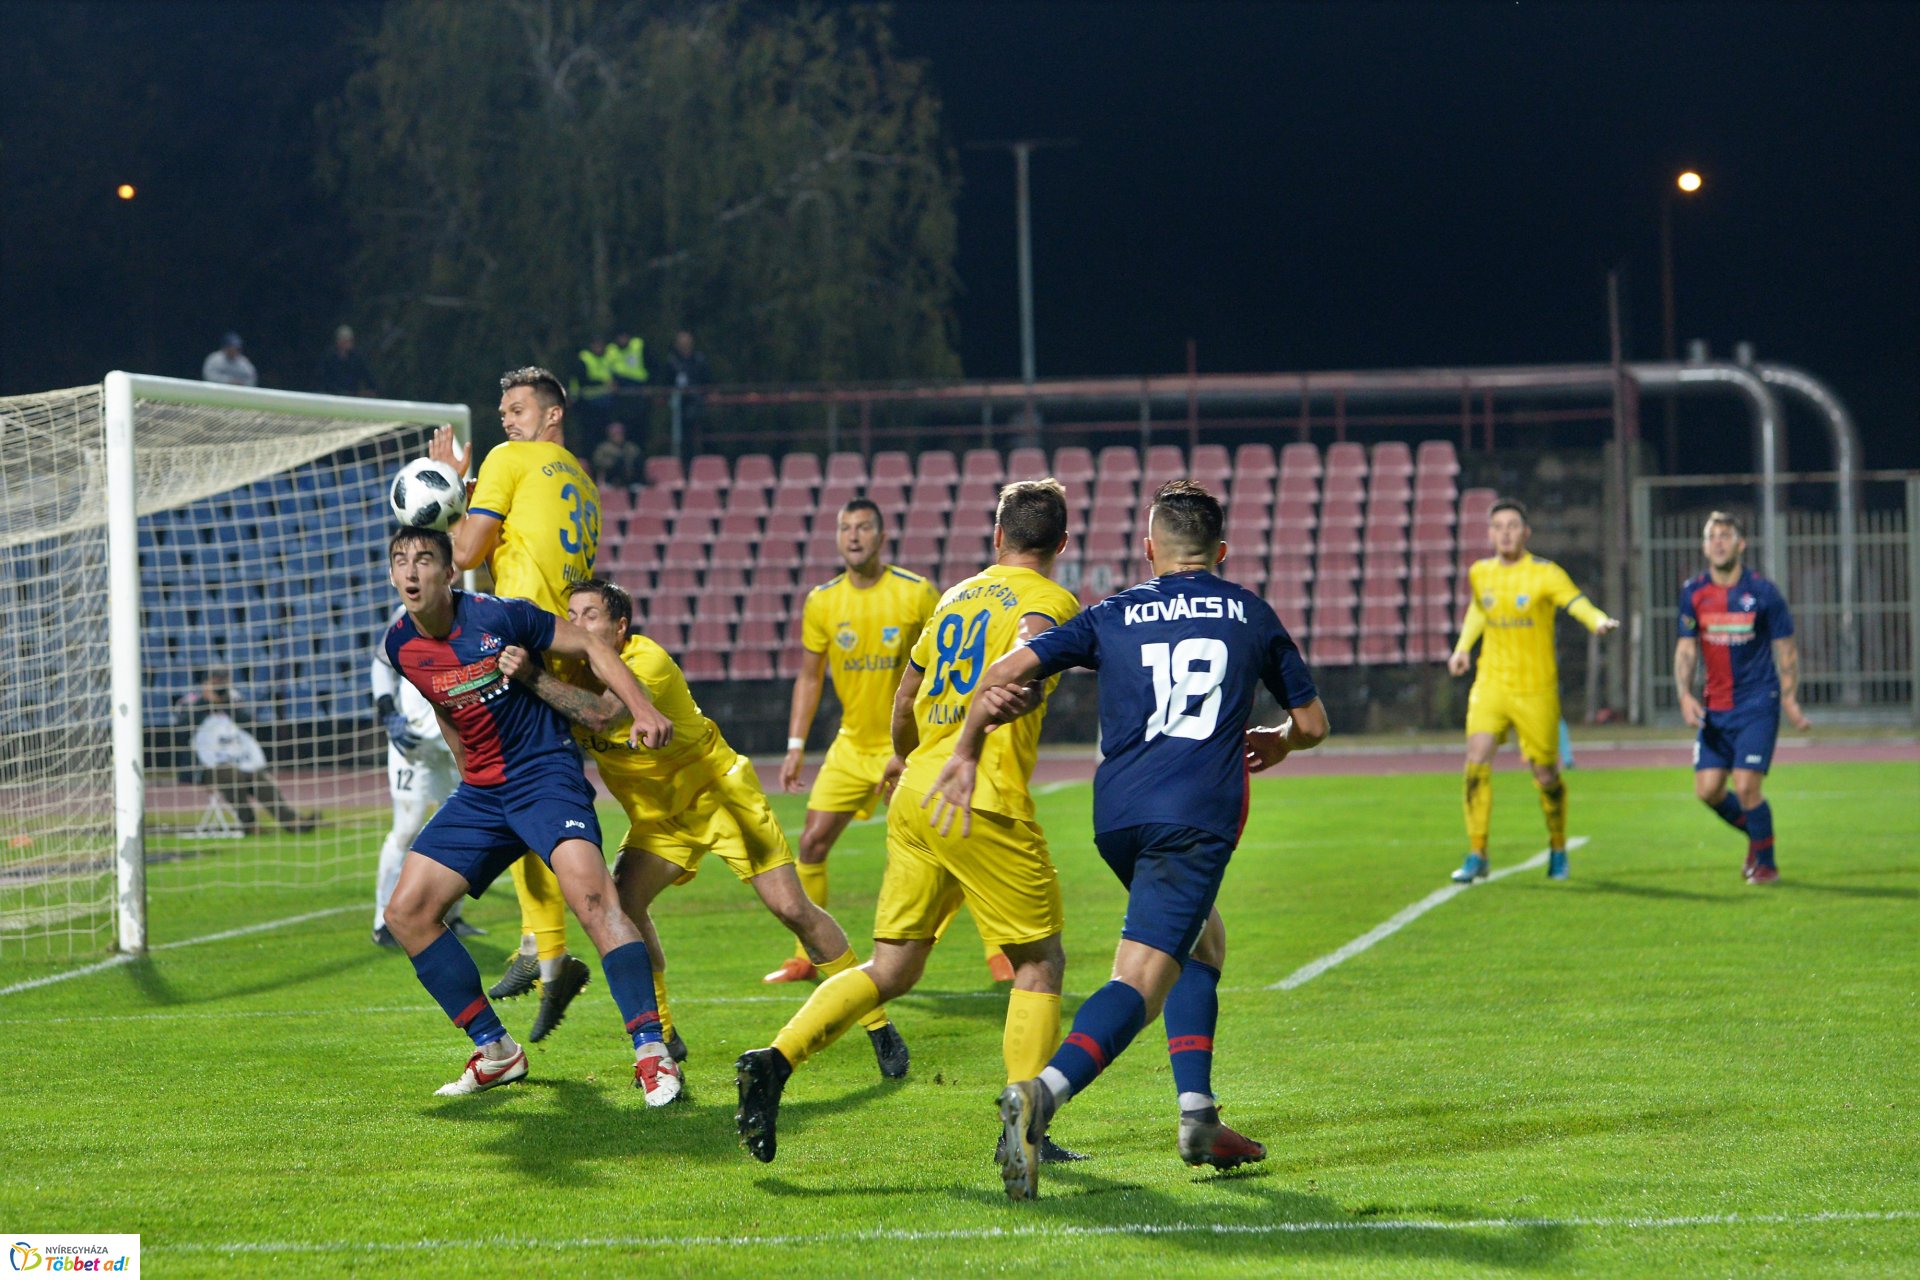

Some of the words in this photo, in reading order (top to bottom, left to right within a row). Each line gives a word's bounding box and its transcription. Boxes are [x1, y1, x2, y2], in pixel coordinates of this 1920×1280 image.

[559, 483, 598, 570] 39
[1124, 593, 1223, 625] KOVÁCS
[1227, 598, 1247, 624] N.
[432, 655, 500, 694] REVES
[928, 609, 991, 697] 89
[1140, 637, 1228, 742] 18
[396, 769, 414, 791] 12
